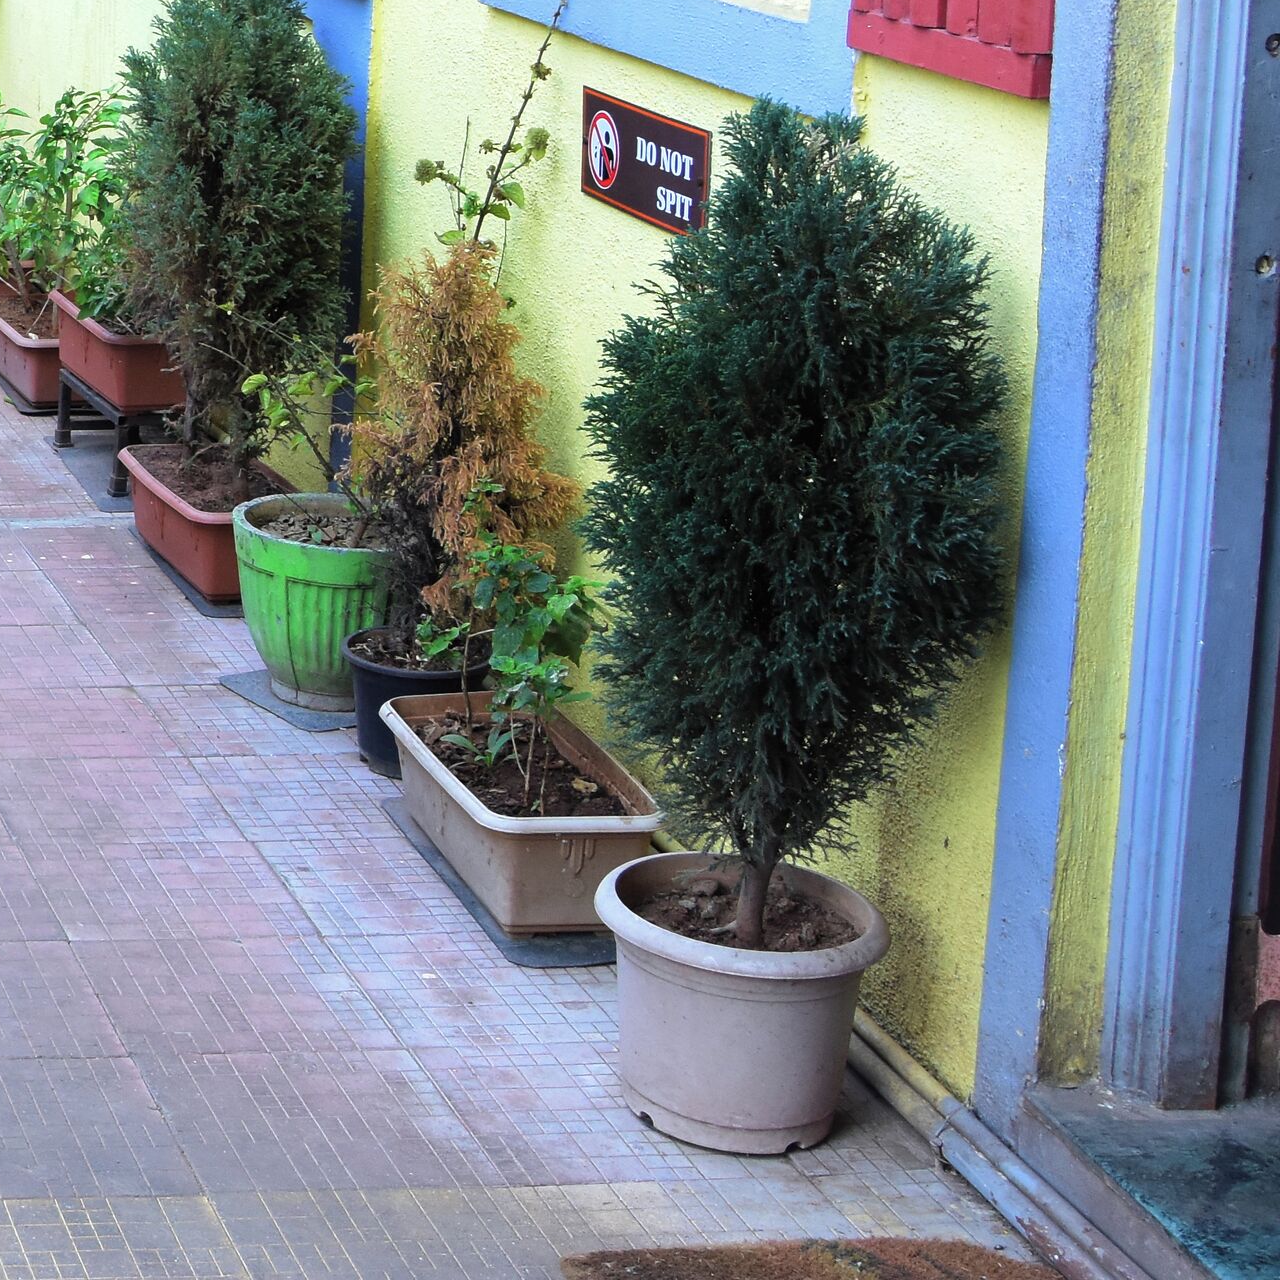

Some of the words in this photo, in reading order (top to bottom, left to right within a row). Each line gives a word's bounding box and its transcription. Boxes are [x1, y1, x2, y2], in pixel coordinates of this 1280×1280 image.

[635, 136, 657, 167] DO
[659, 146, 694, 181] NOT
[656, 186, 693, 222] SPIT
